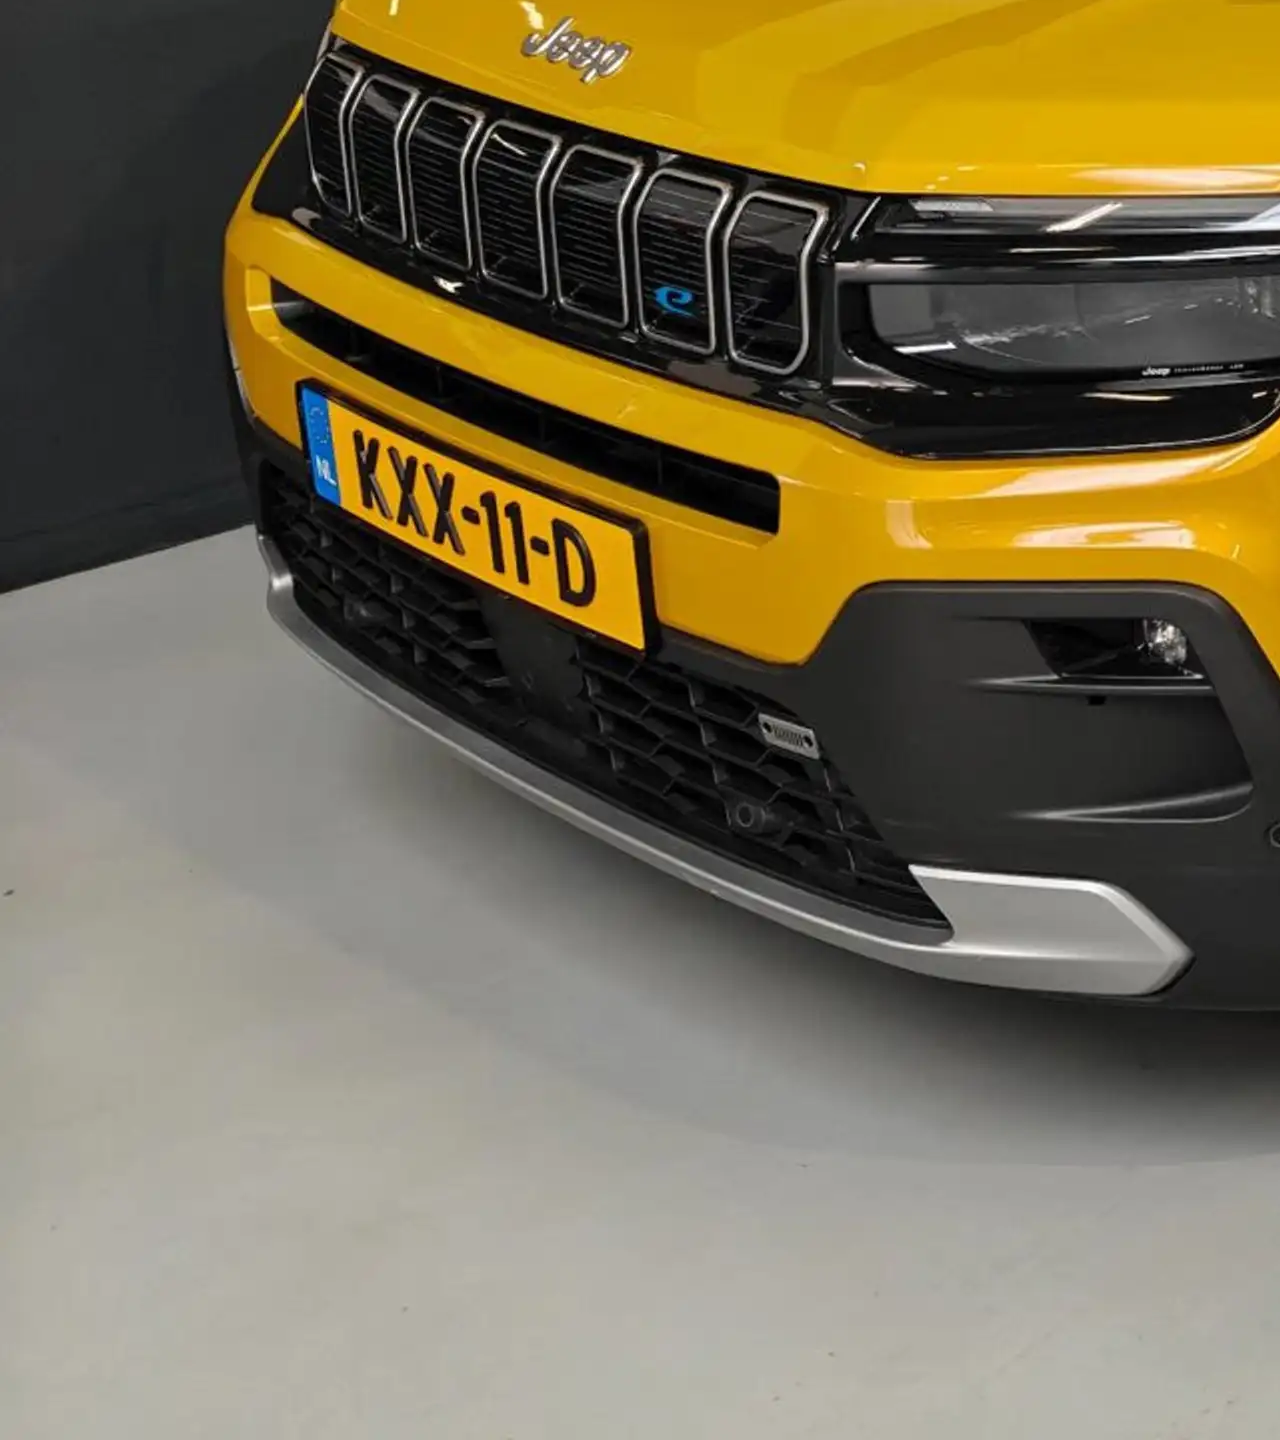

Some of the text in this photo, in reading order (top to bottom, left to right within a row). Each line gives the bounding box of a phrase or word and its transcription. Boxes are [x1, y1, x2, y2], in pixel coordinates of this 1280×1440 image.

[521, 16, 632, 85] Jeep
[315, 454, 338, 488] NL
[353, 429, 597, 608] KXX-11-D
